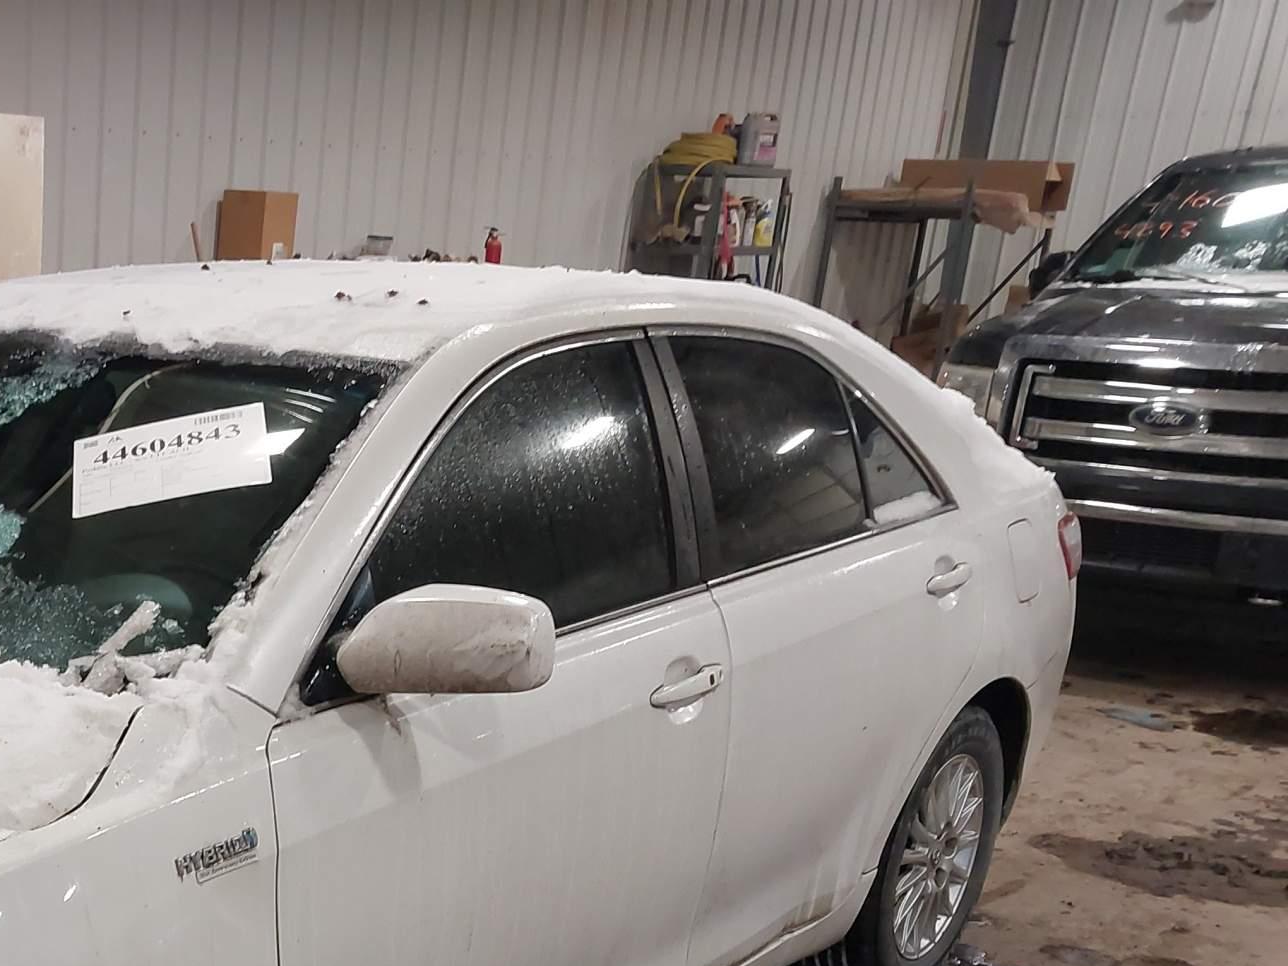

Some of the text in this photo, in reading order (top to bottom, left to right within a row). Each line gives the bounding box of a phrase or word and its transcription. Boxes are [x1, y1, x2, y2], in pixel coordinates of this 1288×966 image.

[1144, 407, 1187, 425] Ford
[93, 423, 242, 465] 44604843
[174, 834, 248, 877] HYBRID
